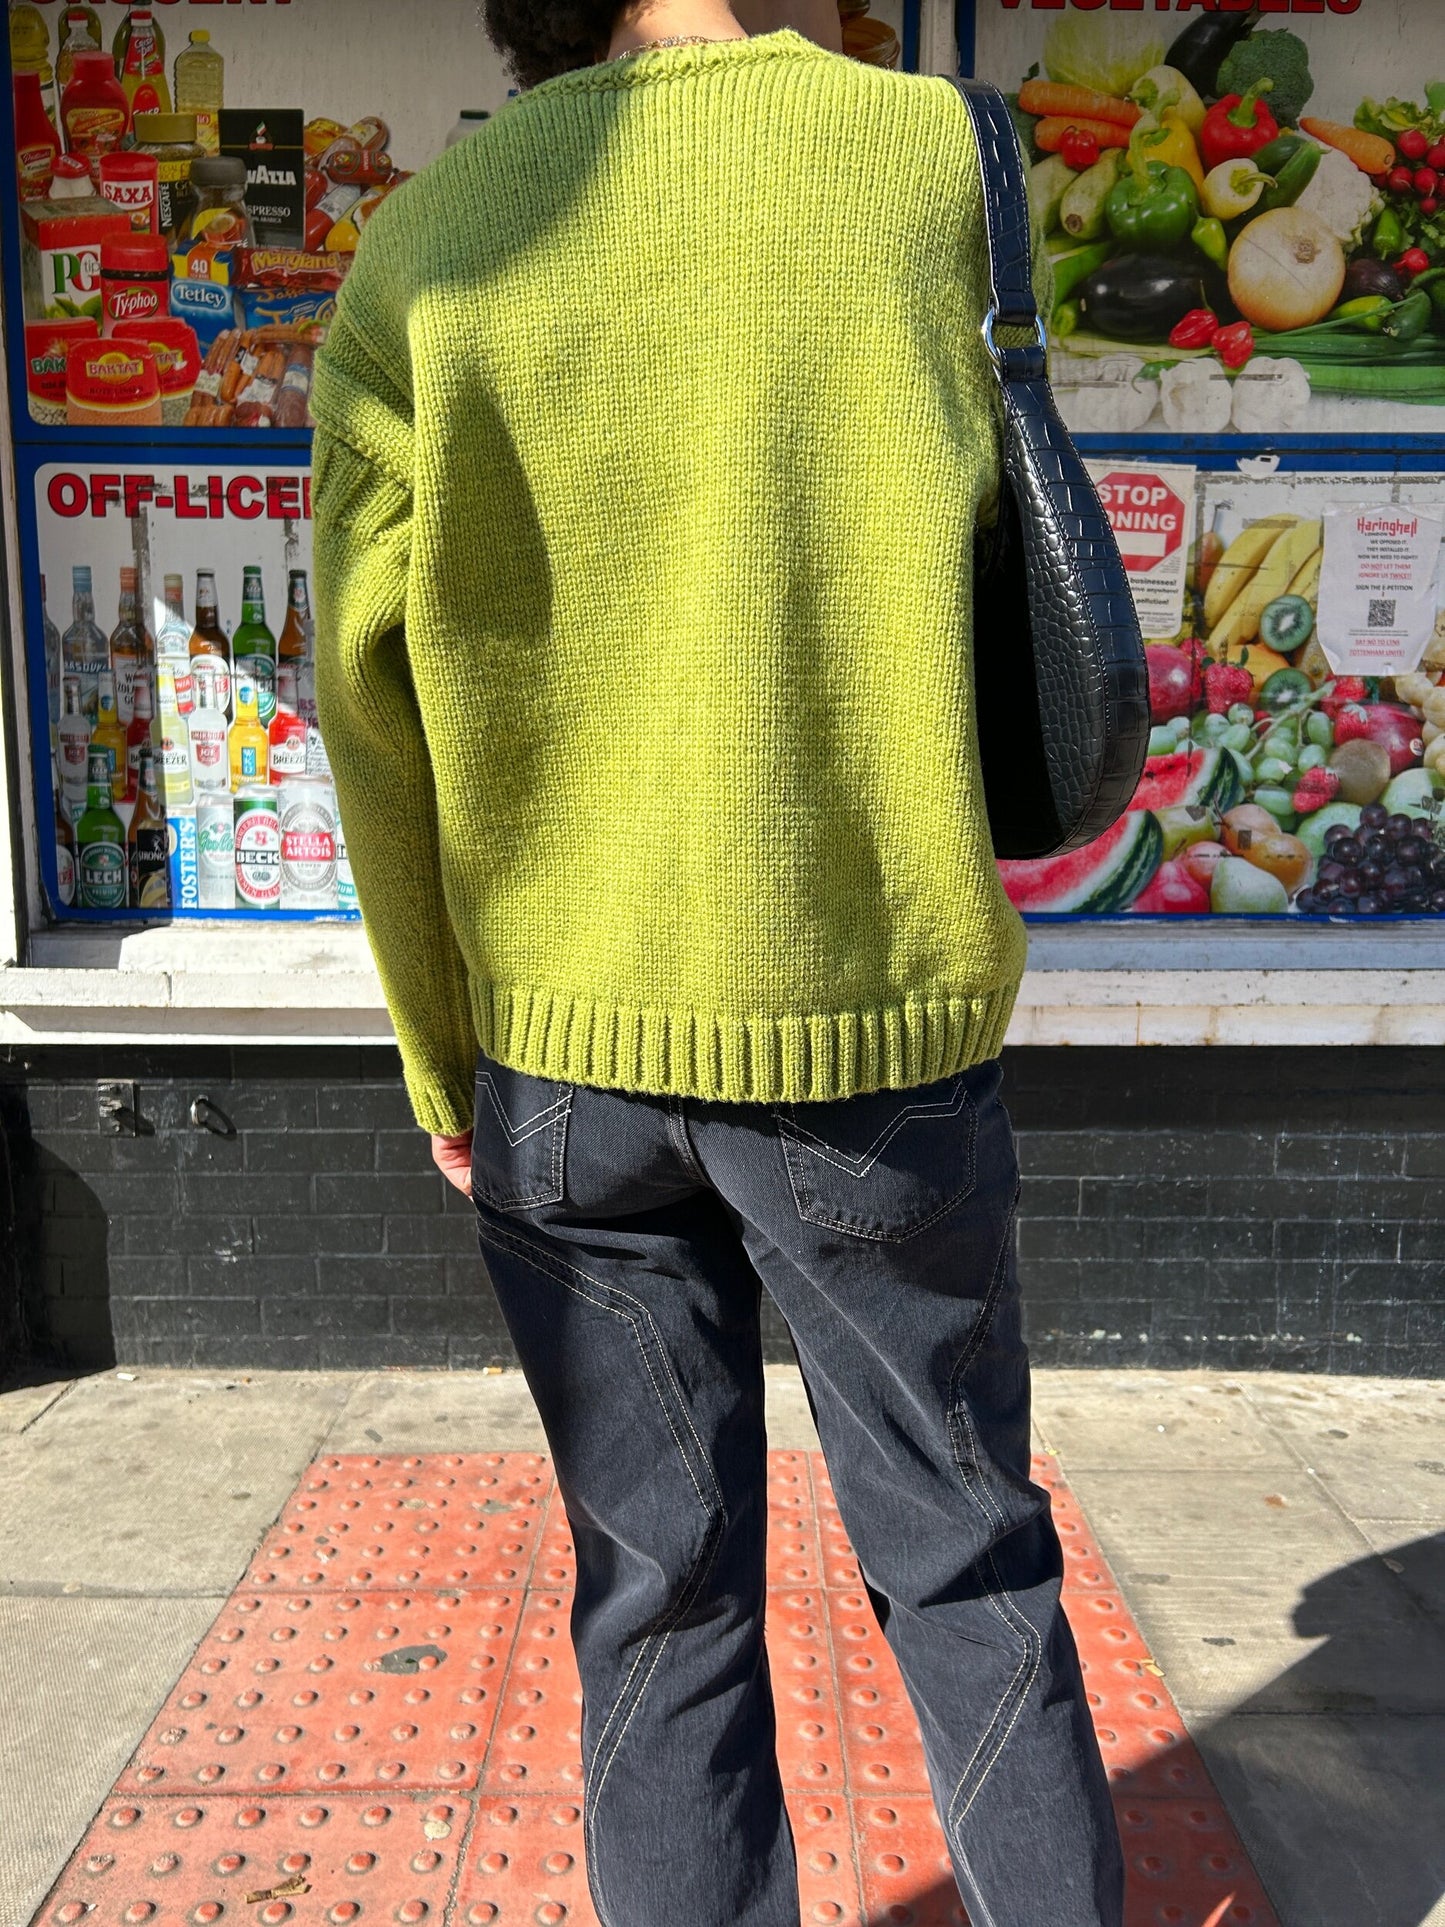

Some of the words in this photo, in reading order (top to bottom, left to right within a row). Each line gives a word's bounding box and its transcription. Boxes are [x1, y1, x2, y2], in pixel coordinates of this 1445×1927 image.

[247, 165, 297, 186] VAZZA
[104, 182, 151, 203] SAXA
[247, 205, 291, 217] SPRESSO
[50, 250, 100, 294] PG
[191, 259, 208, 274] 40
[252, 252, 338, 275] Maryland
[176, 286, 224, 307] Tetley
[31, 356, 67, 376] BAK
[89, 362, 140, 375] BAKTAT
[47, 472, 313, 520] OFF-LICE
[1097, 483, 1168, 507] STOP
[1357, 517, 1418, 538] Haringhell
[1130, 578, 1177, 586] businesses!
[286, 835, 331, 847] STELLA
[286, 847, 332, 857] ARTOIS
[85, 869, 122, 885] LECH
